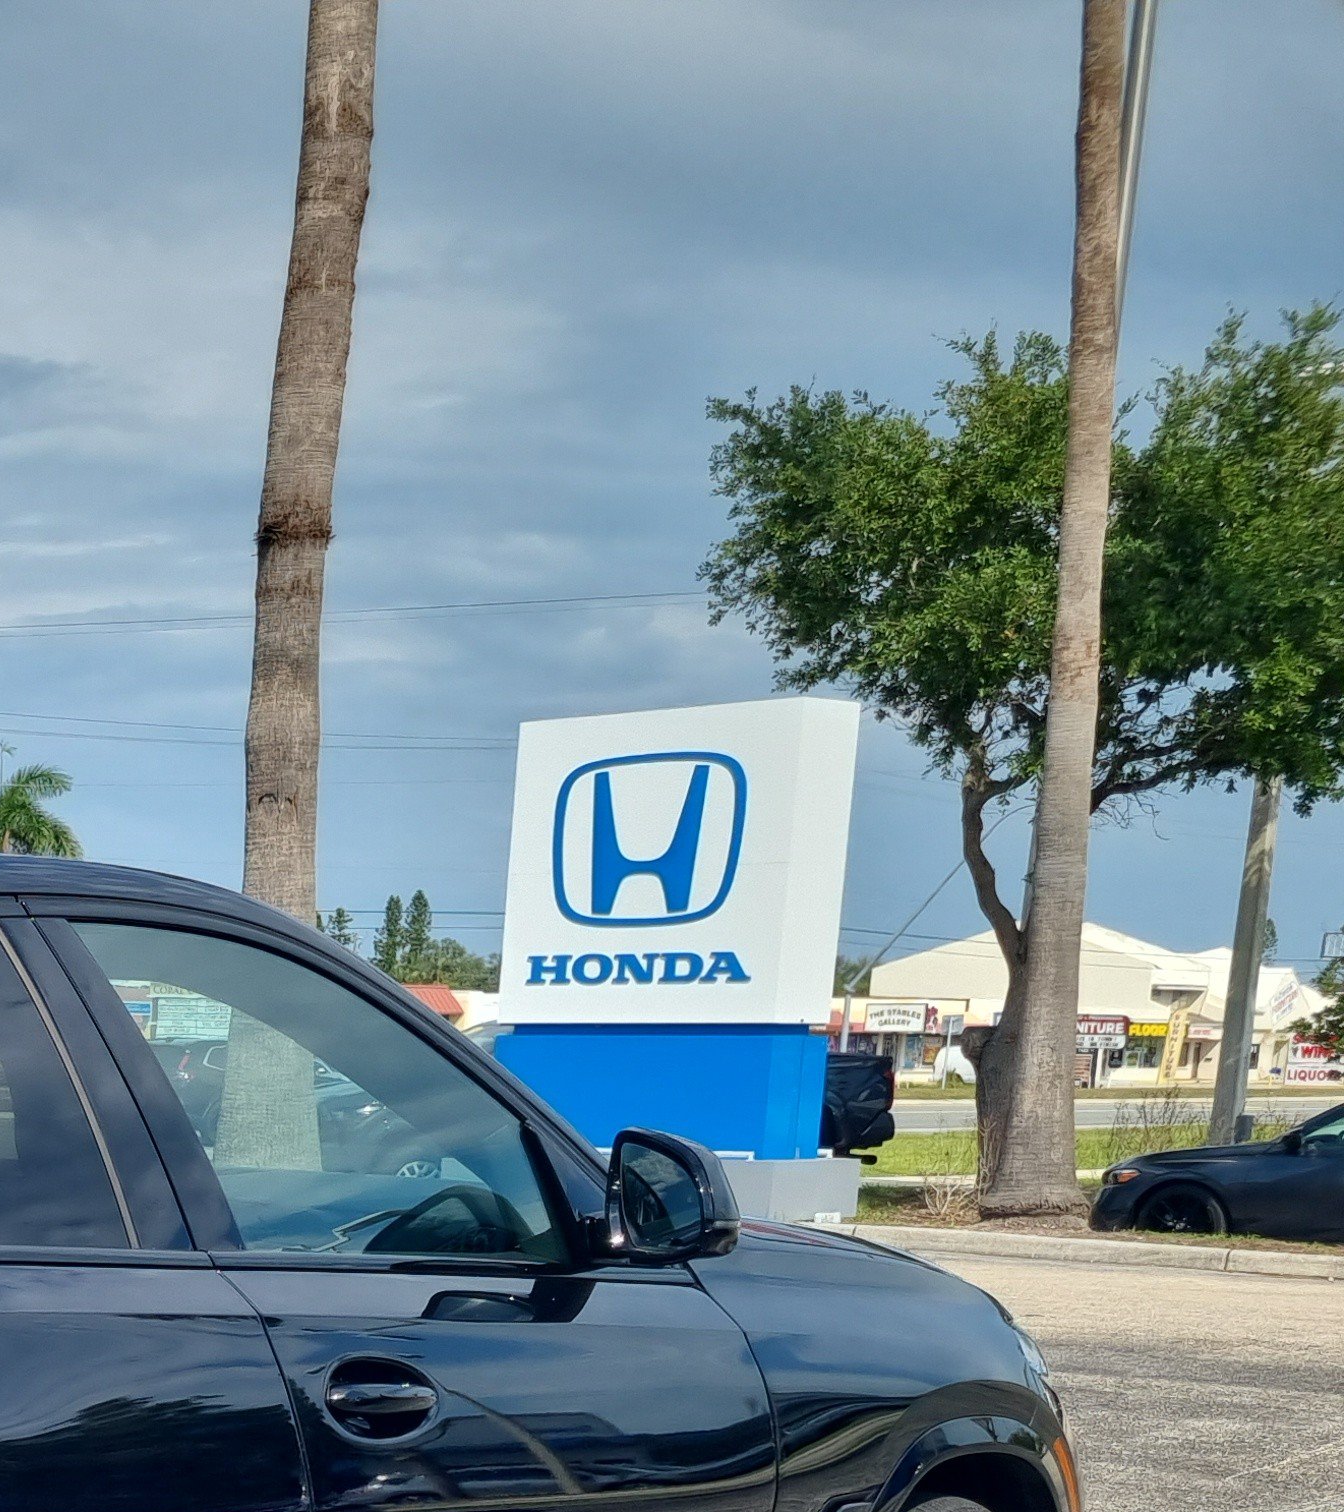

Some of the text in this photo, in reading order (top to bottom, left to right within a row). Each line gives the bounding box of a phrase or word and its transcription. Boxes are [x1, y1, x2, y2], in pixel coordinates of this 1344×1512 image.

[525, 951, 752, 987] HONDA
[869, 1009, 885, 1020] THE
[878, 1018, 912, 1027] GALLERY
[1287, 1069, 1335, 1082] LIQUO
